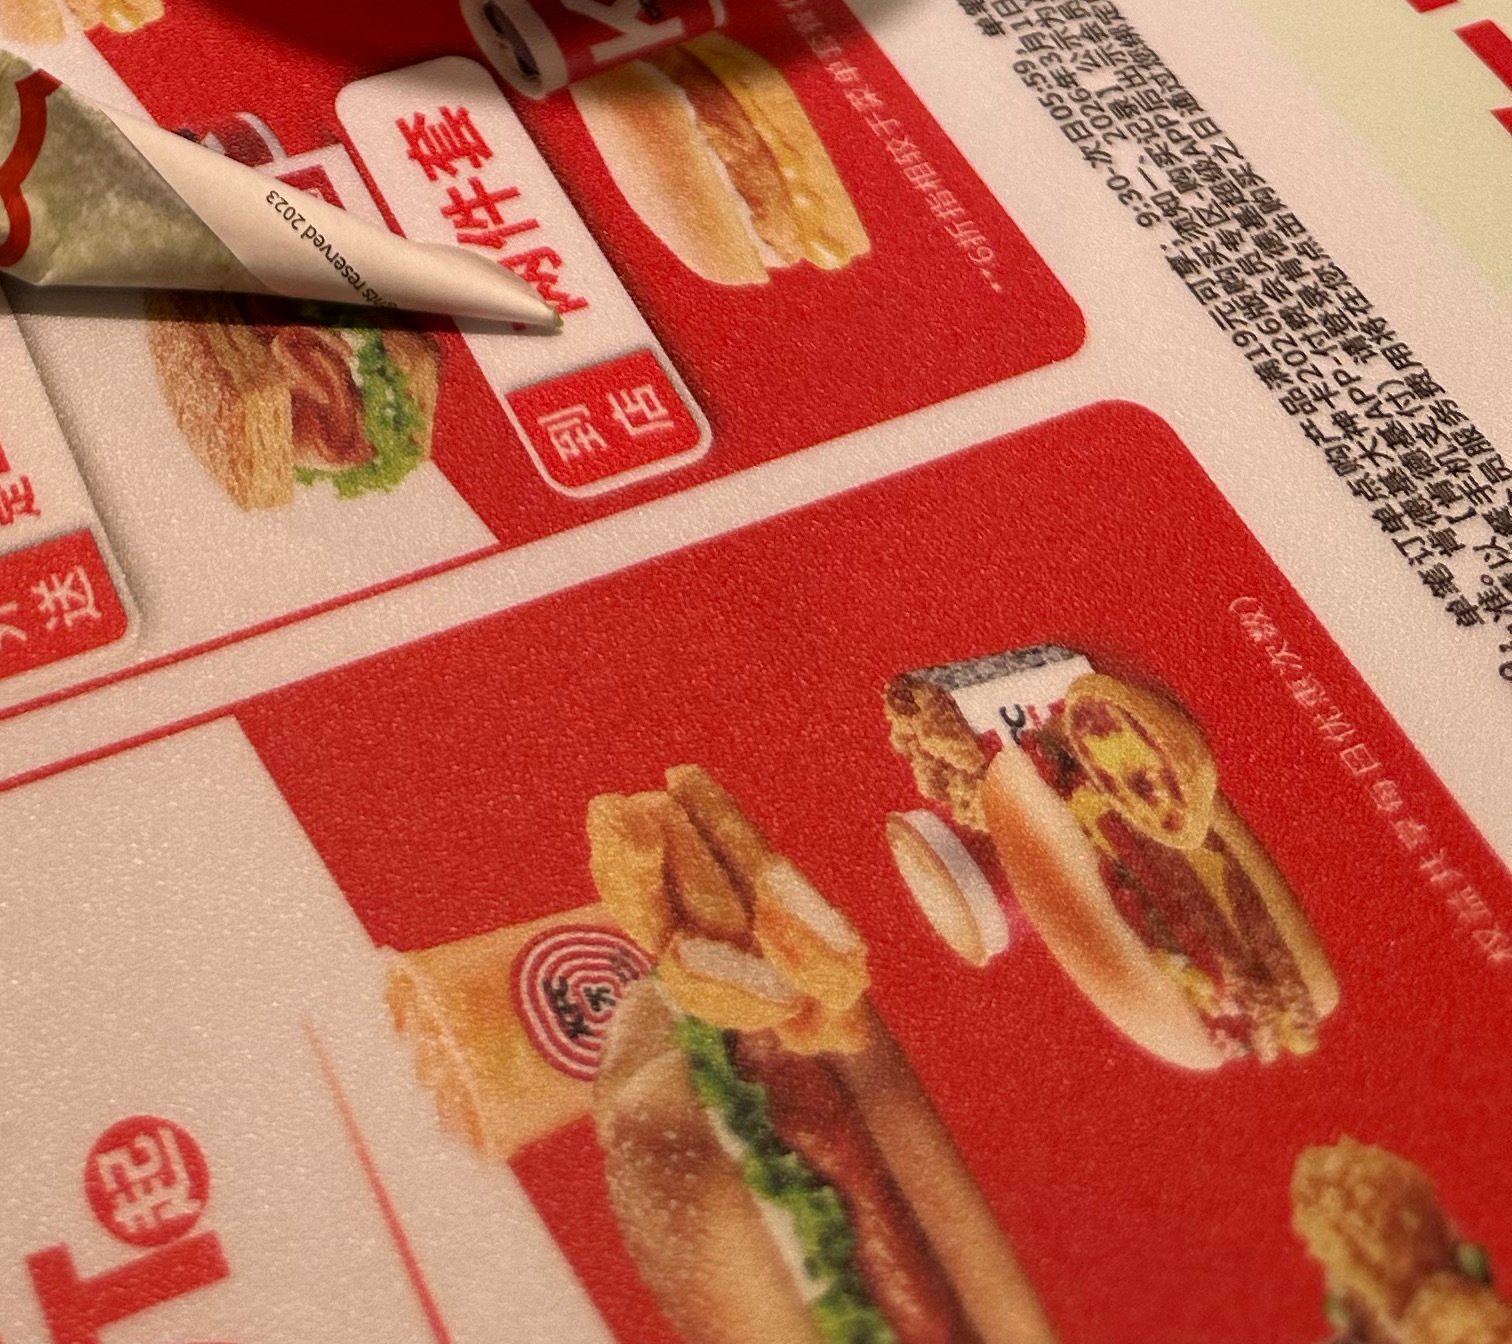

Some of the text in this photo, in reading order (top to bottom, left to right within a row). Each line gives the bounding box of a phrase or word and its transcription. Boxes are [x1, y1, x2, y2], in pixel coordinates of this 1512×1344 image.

[265, 188, 307, 232] 2023
[300, 223, 368, 292] reserved
[538, 384, 676, 462] 到店
